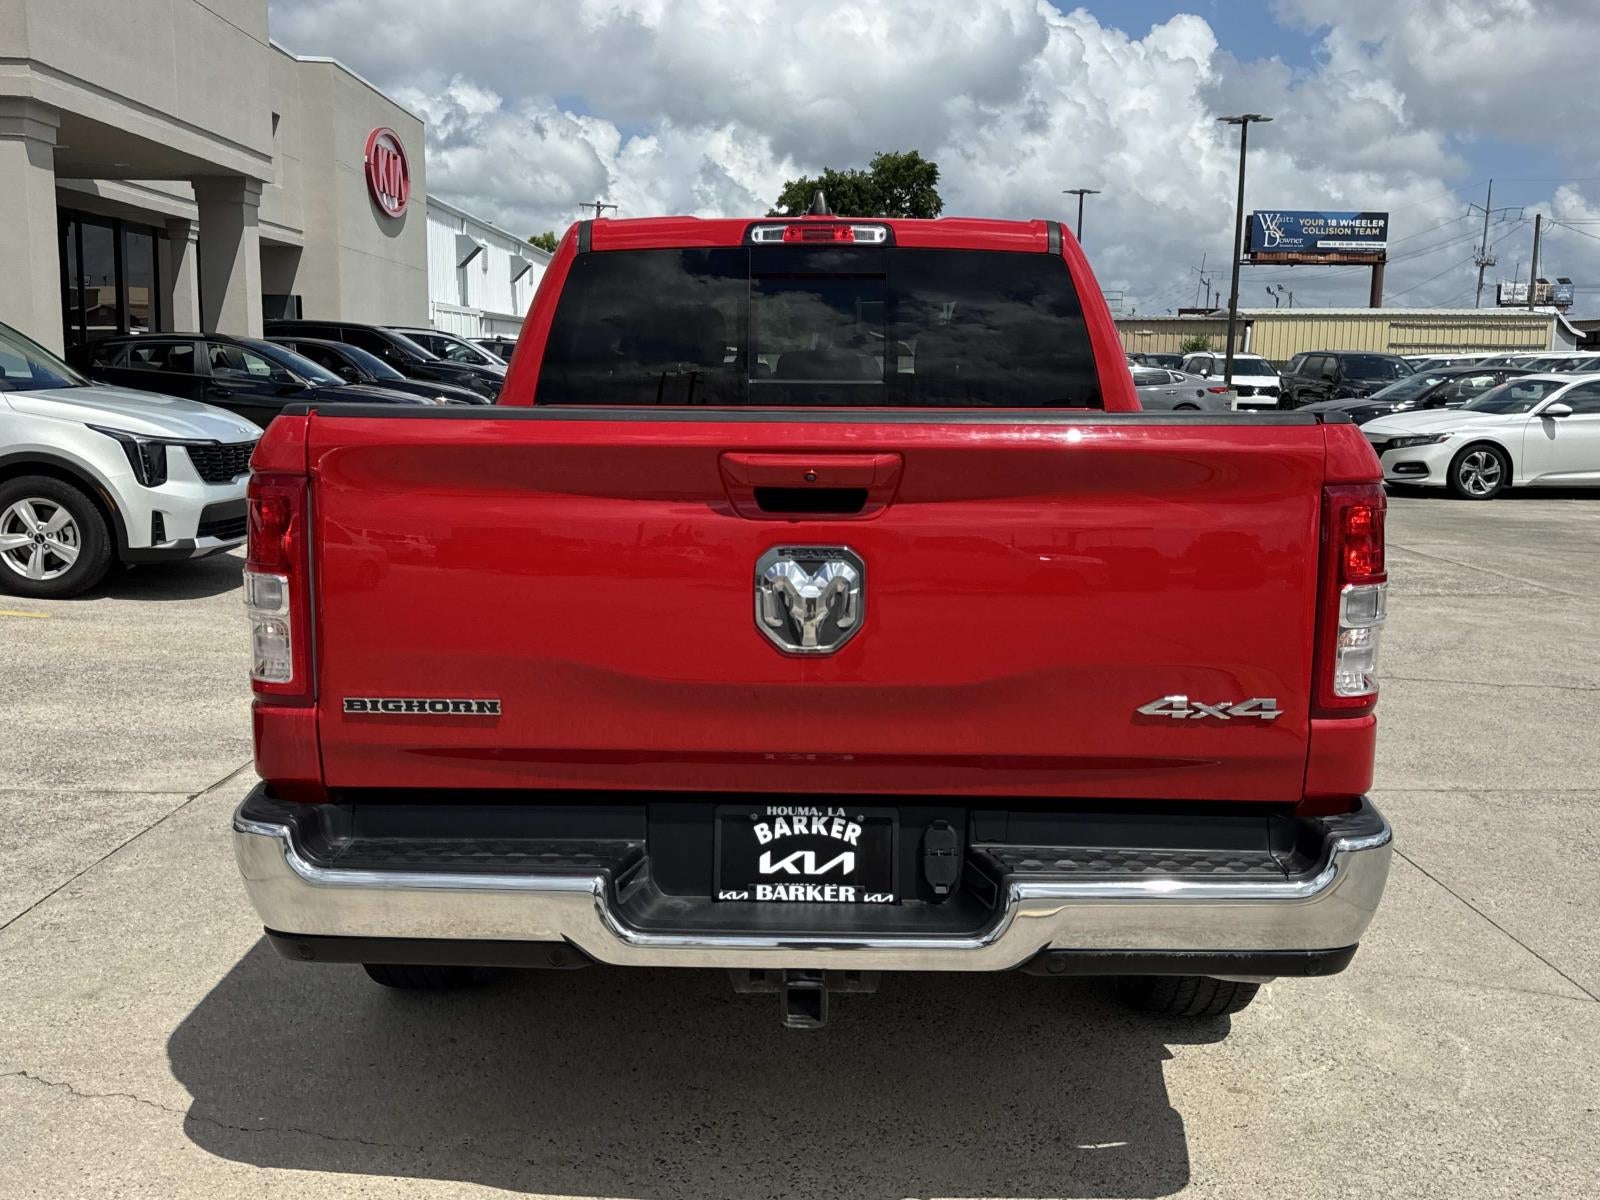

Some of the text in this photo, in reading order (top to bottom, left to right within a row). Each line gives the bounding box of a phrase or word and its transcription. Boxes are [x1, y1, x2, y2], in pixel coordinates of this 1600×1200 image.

[1299, 218, 1385, 228] YOUR 18 WHEELER
[1302, 226, 1380, 236] COLLISION TEAM
[1263, 230, 1304, 248] Downer
[343, 697, 502, 716] BIGHORN
[766, 806, 846, 817] HOUMA, LA
[753, 816, 862, 847] BARKER
[759, 850, 855, 876] KIA
[718, 890, 749, 900] KIA
[756, 884, 856, 902] BARKER
[863, 893, 894, 903] KIA
